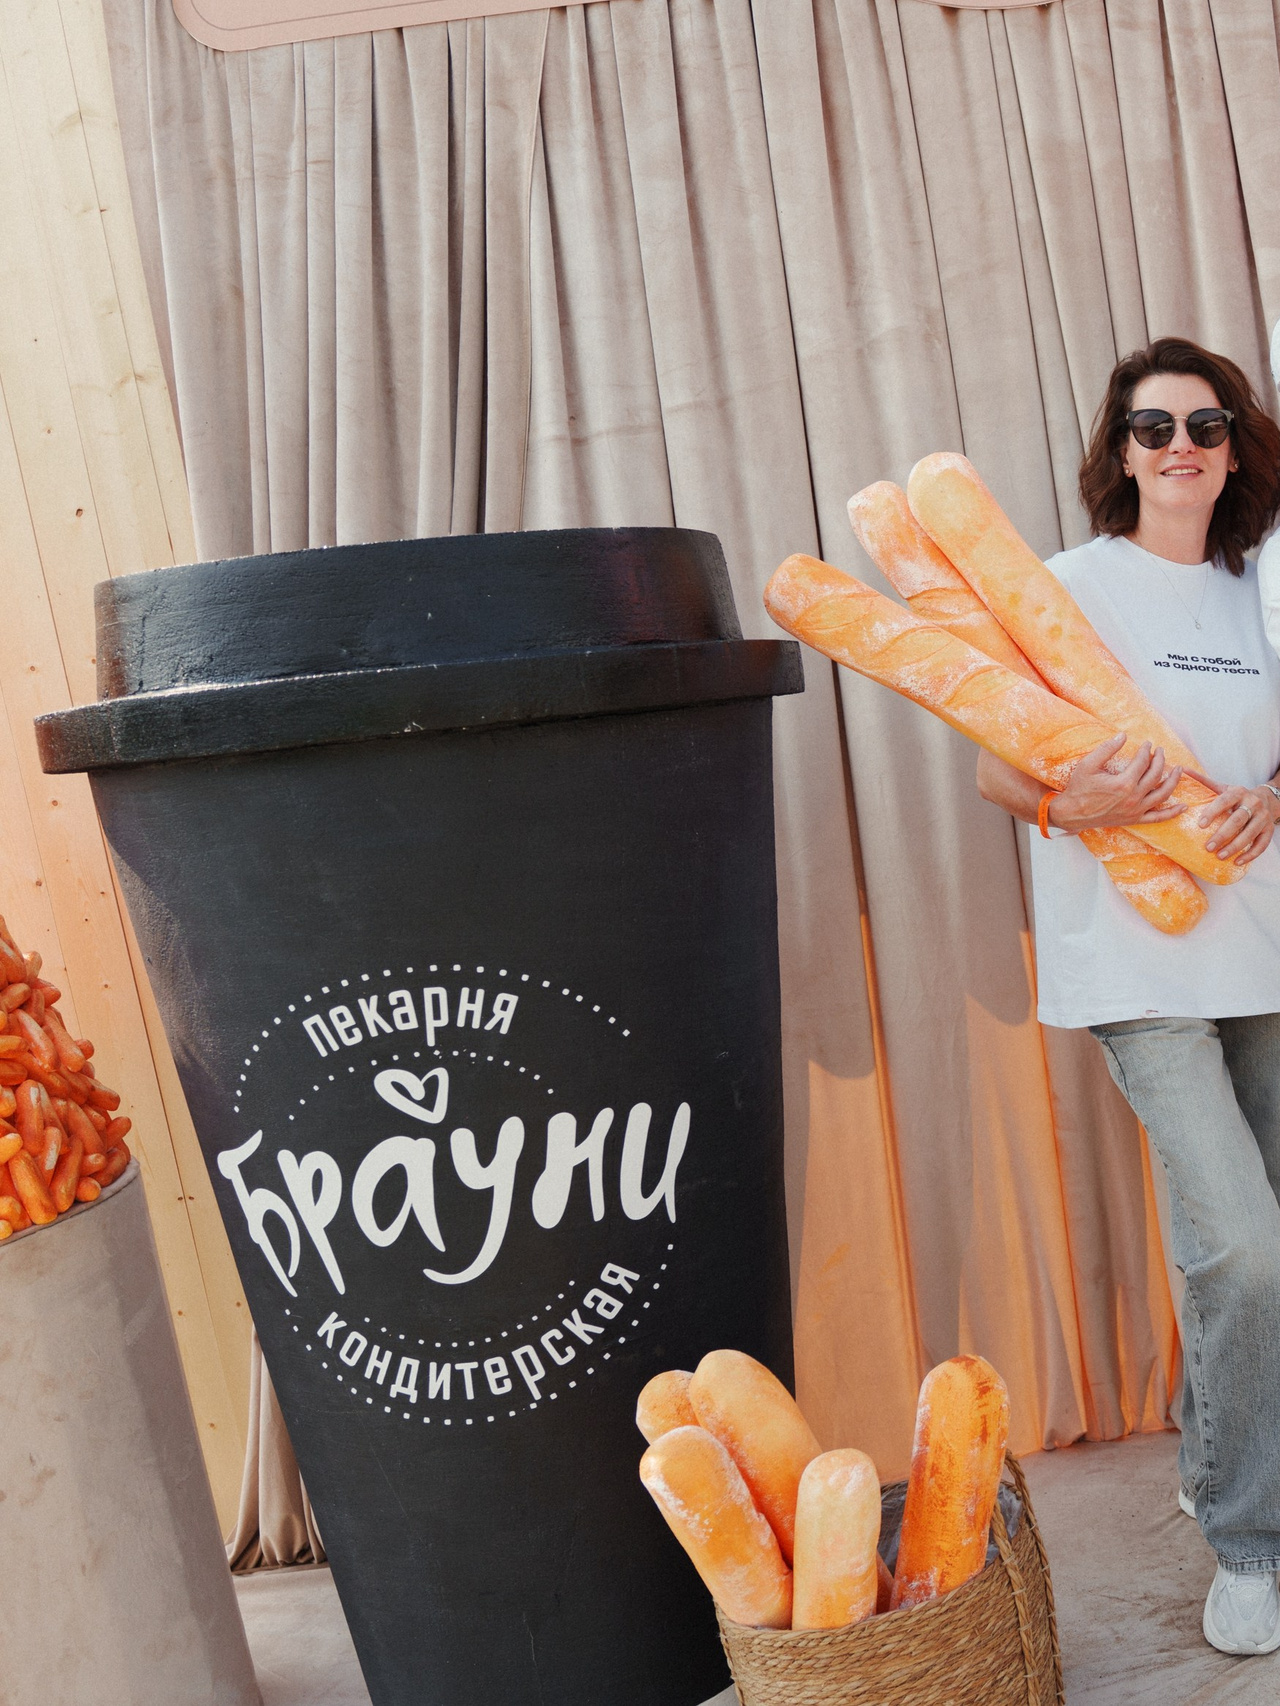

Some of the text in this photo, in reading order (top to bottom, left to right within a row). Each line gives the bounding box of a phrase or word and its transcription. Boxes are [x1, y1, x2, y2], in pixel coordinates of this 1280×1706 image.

[1154, 660, 1260, 675] из одного теста
[1167, 653, 1188, 662] мы
[1201, 657, 1241, 666] тобой
[302, 986, 519, 1058] пекарня
[216, 1101, 692, 1298] Брауни
[316, 1262, 641, 1403] кондитерская
